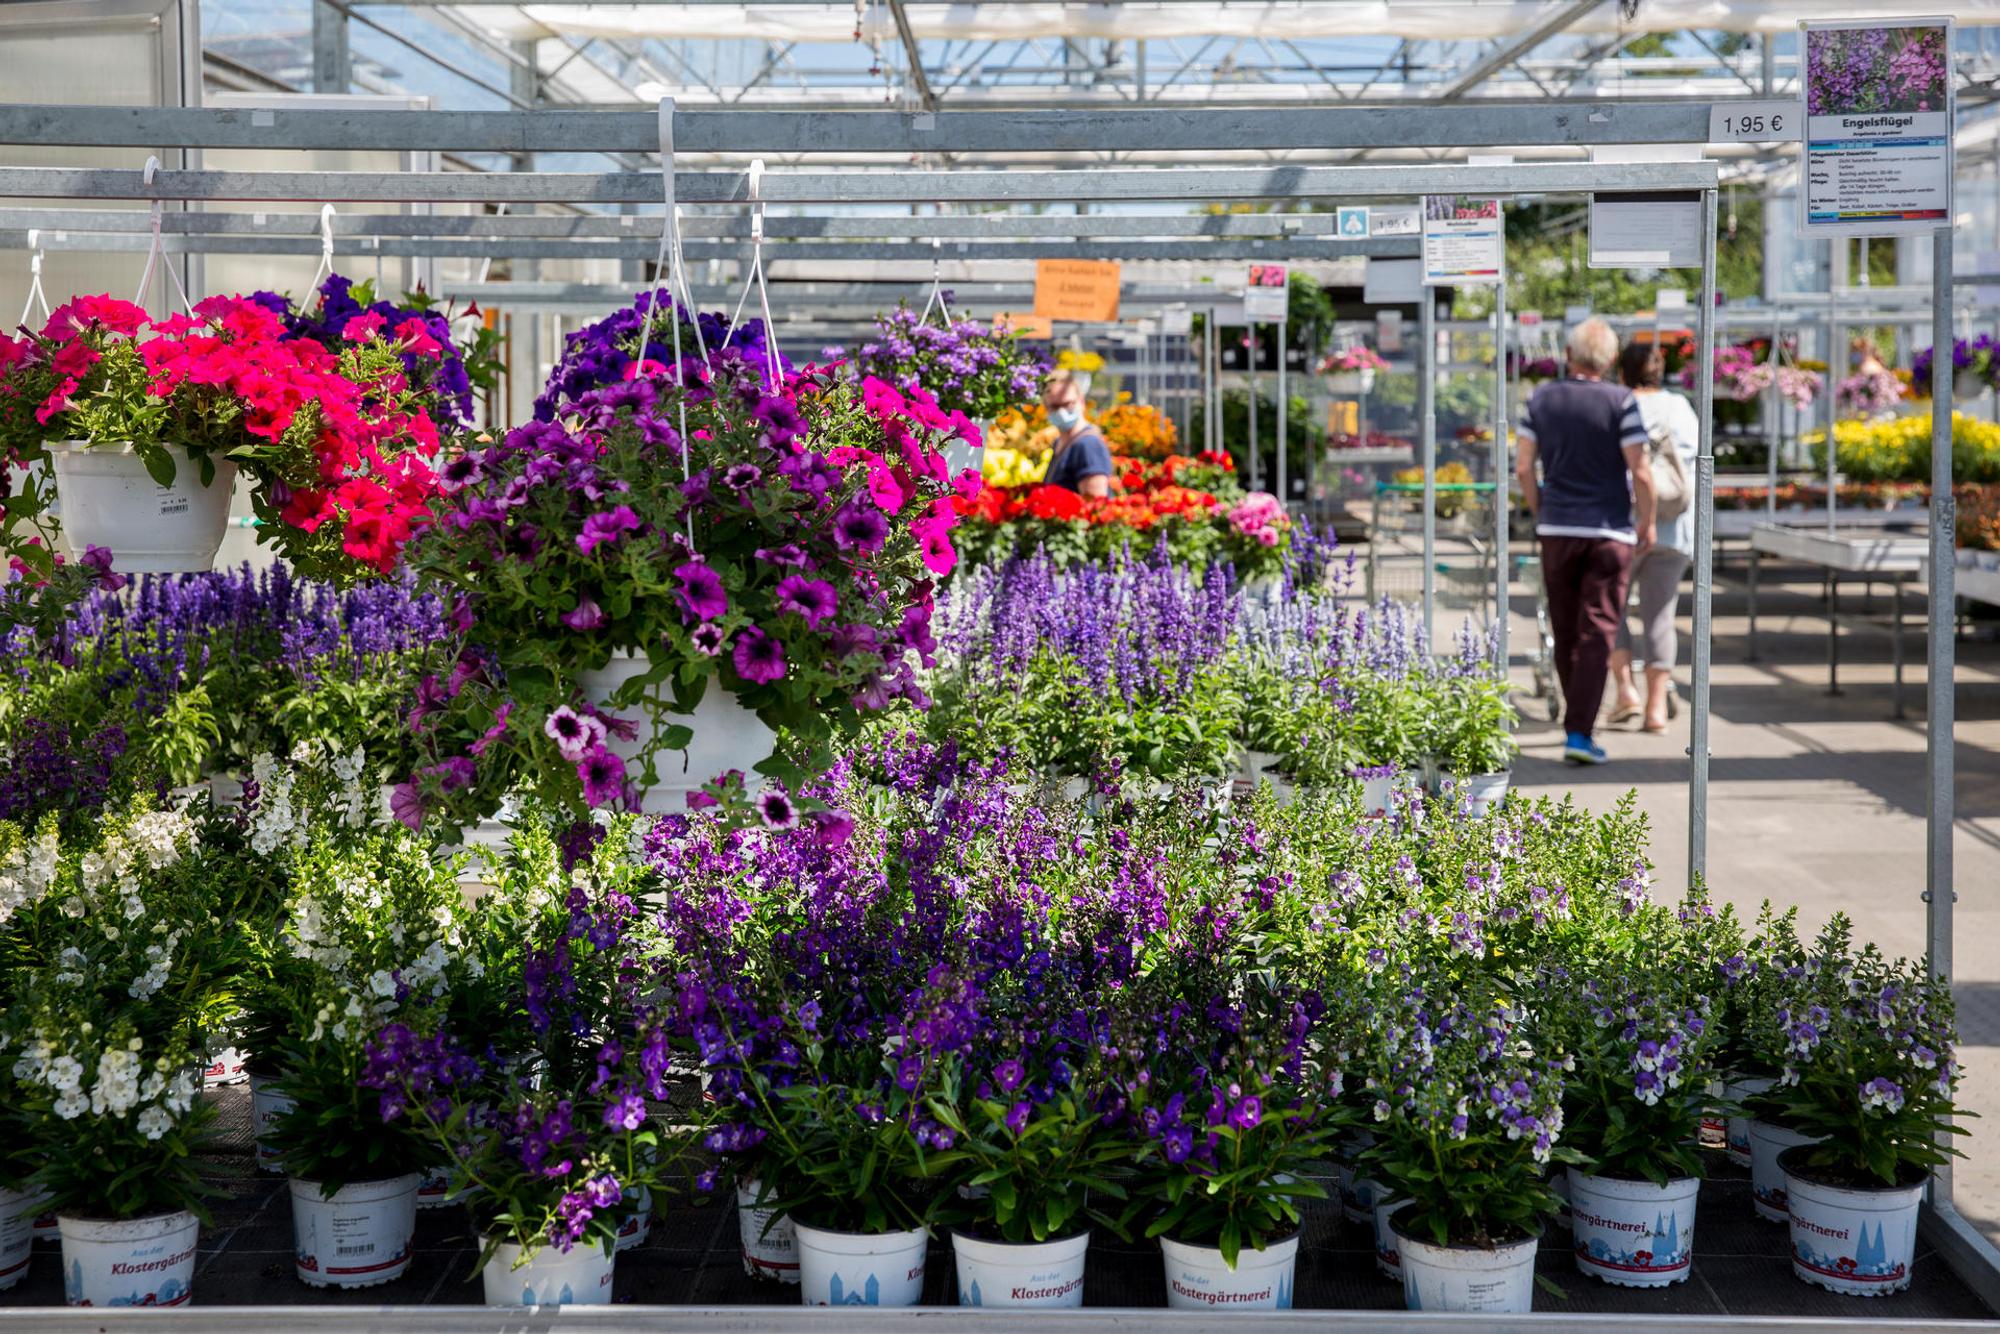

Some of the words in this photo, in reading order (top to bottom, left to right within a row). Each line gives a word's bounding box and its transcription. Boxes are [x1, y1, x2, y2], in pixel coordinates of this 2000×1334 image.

[1724, 116, 1764, 136] 1,95
[1771, 115, 1783, 132] €
[1842, 116, 1913, 130] Engelsflügel
[1172, 1279, 1272, 1305] Klostergärtnerei
